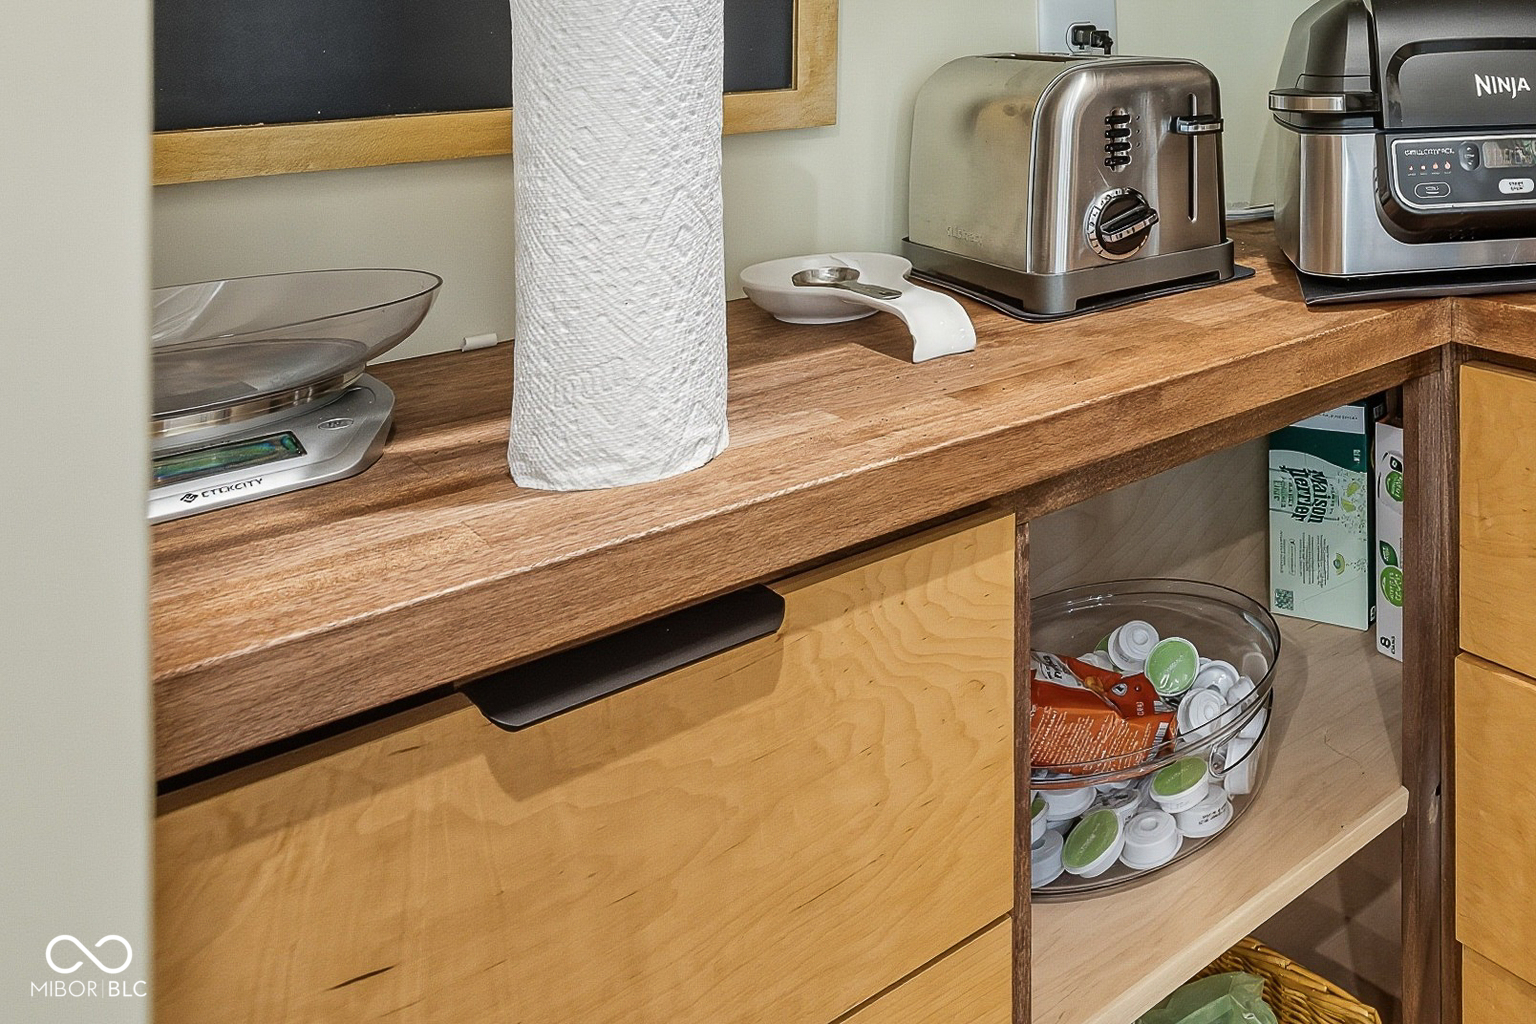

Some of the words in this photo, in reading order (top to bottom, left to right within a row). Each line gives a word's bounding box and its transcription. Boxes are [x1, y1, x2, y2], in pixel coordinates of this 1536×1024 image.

[1474, 73, 1531, 99] NINJA
[1307, 468, 1329, 524] Maison
[1379, 636, 1392, 649] 8
